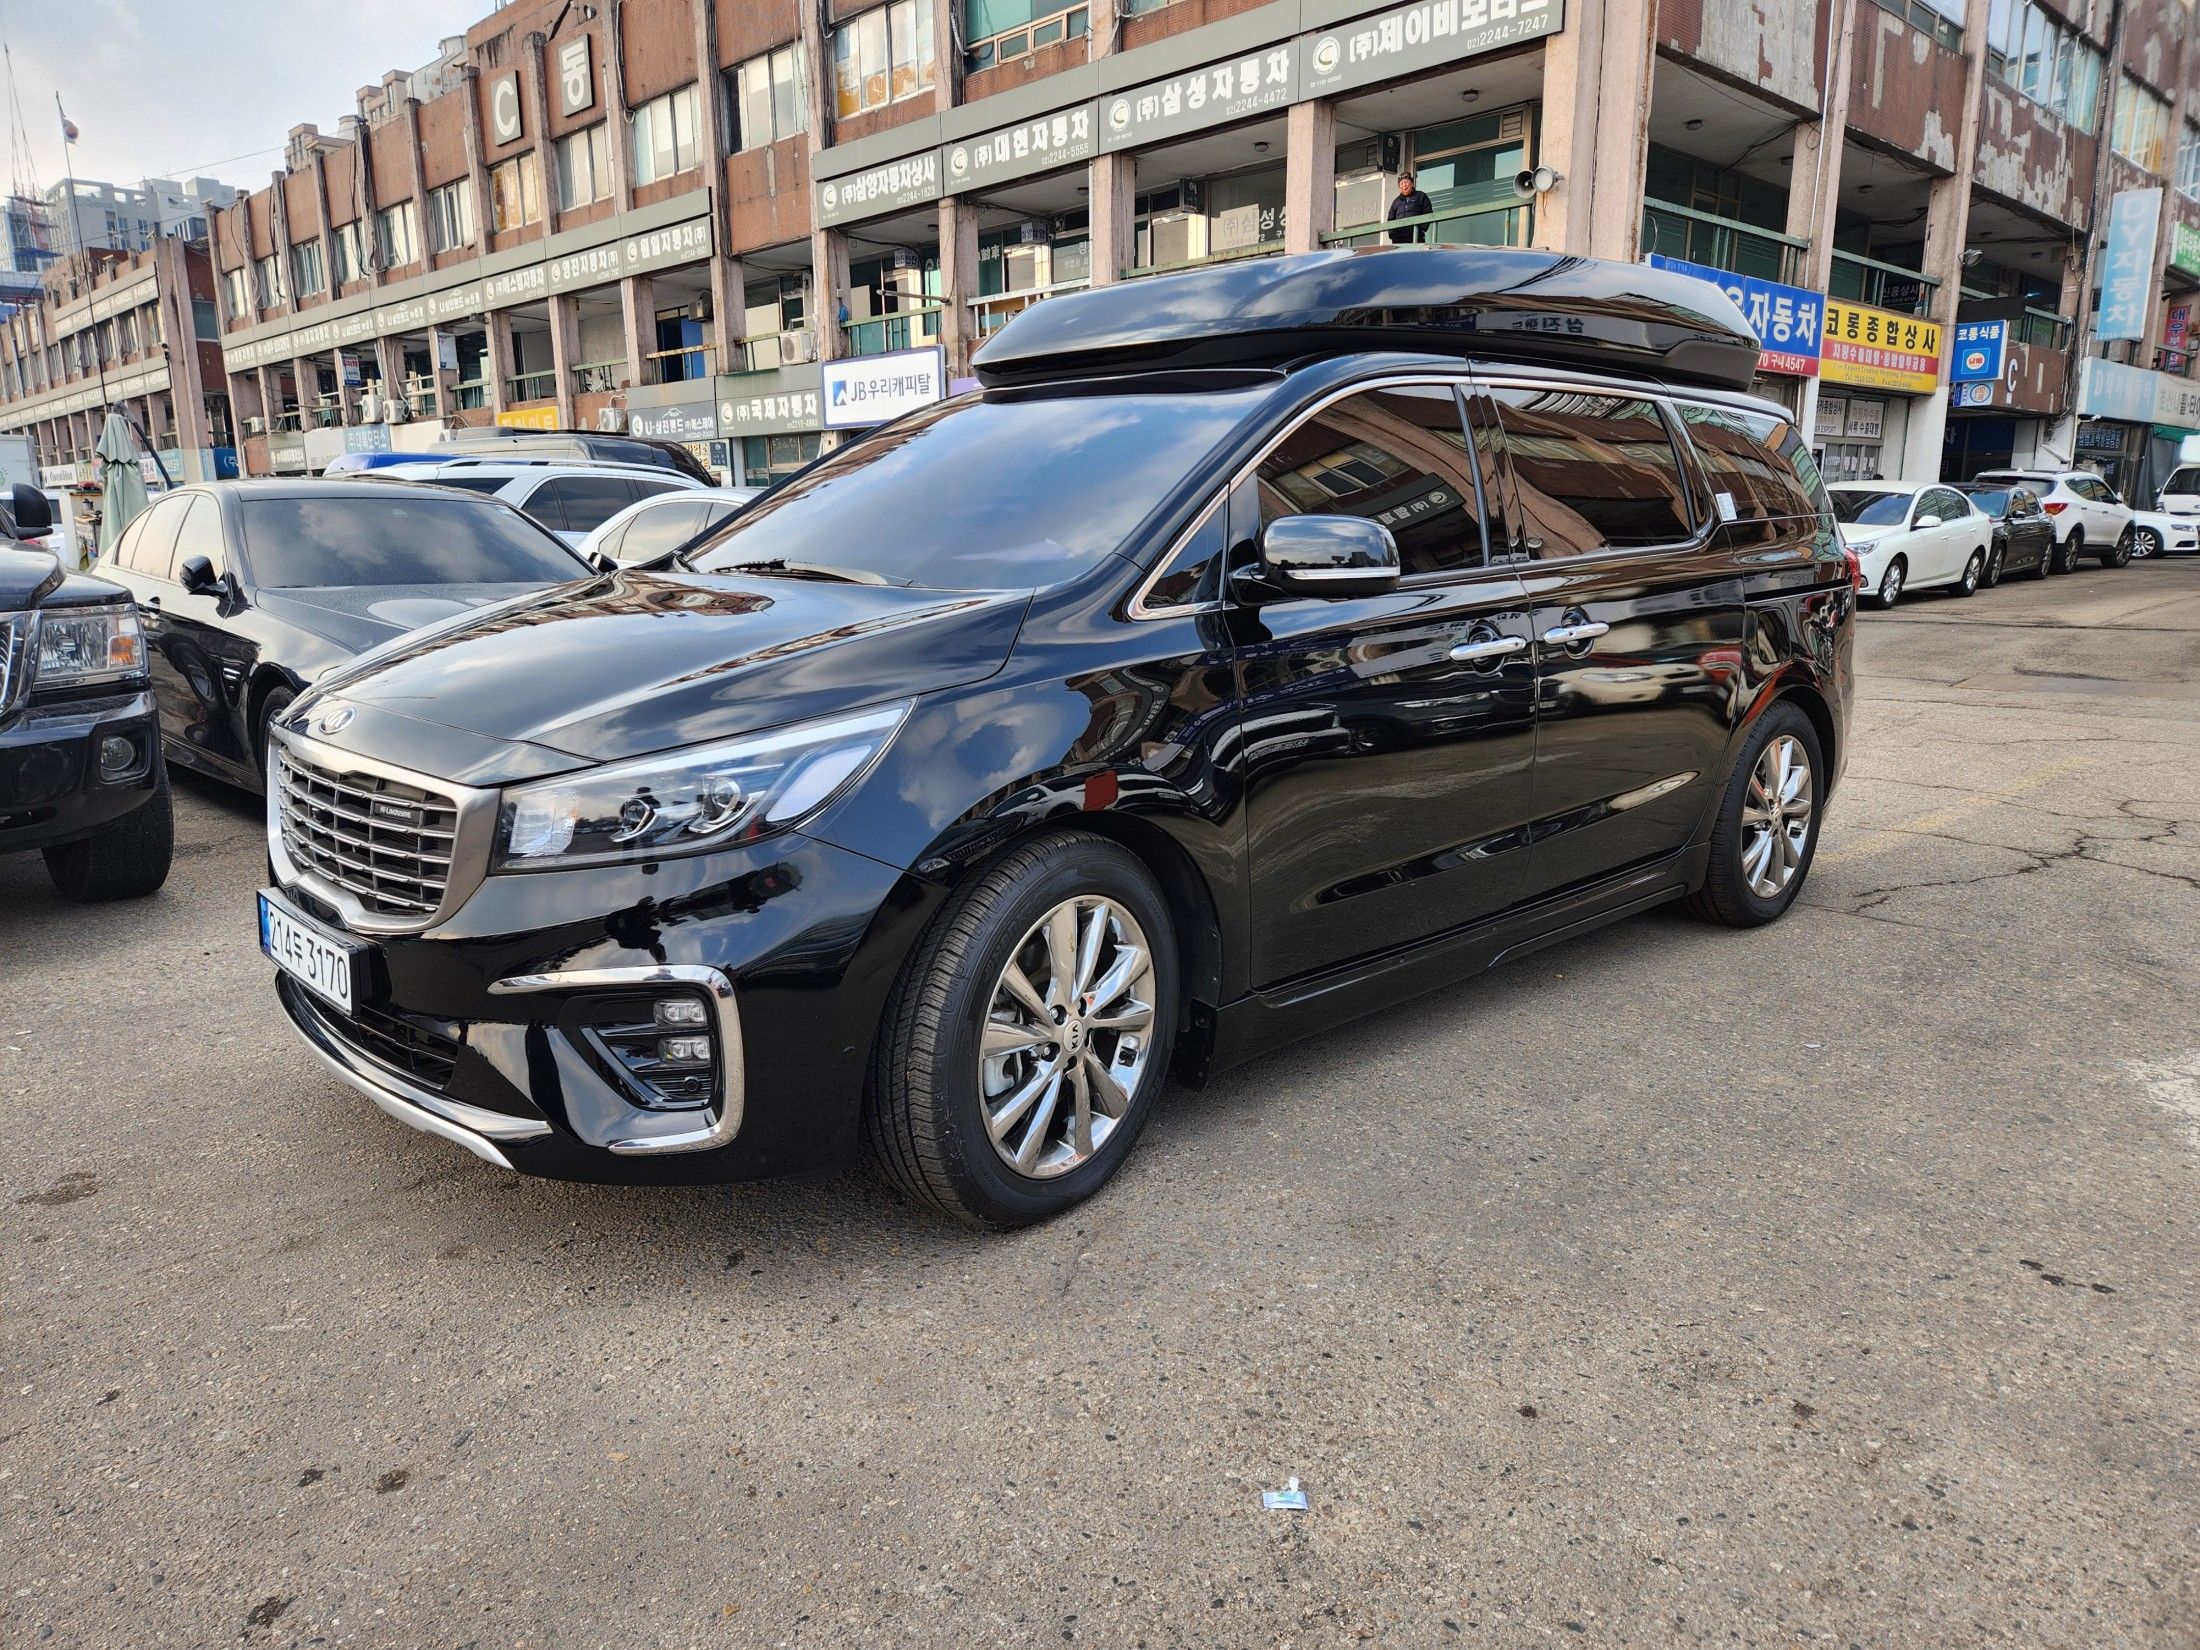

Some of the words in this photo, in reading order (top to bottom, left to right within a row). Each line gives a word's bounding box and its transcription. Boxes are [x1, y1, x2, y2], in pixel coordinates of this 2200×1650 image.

[562, 41, 586, 107] 동
[1136, 49, 1290, 123] (주)삼성자동차
[1826, 308, 1936, 354] 코롱종합상사
[850, 373, 931, 402] JB우리캐피탈
[1071, 1024, 1079, 1049] KIA
